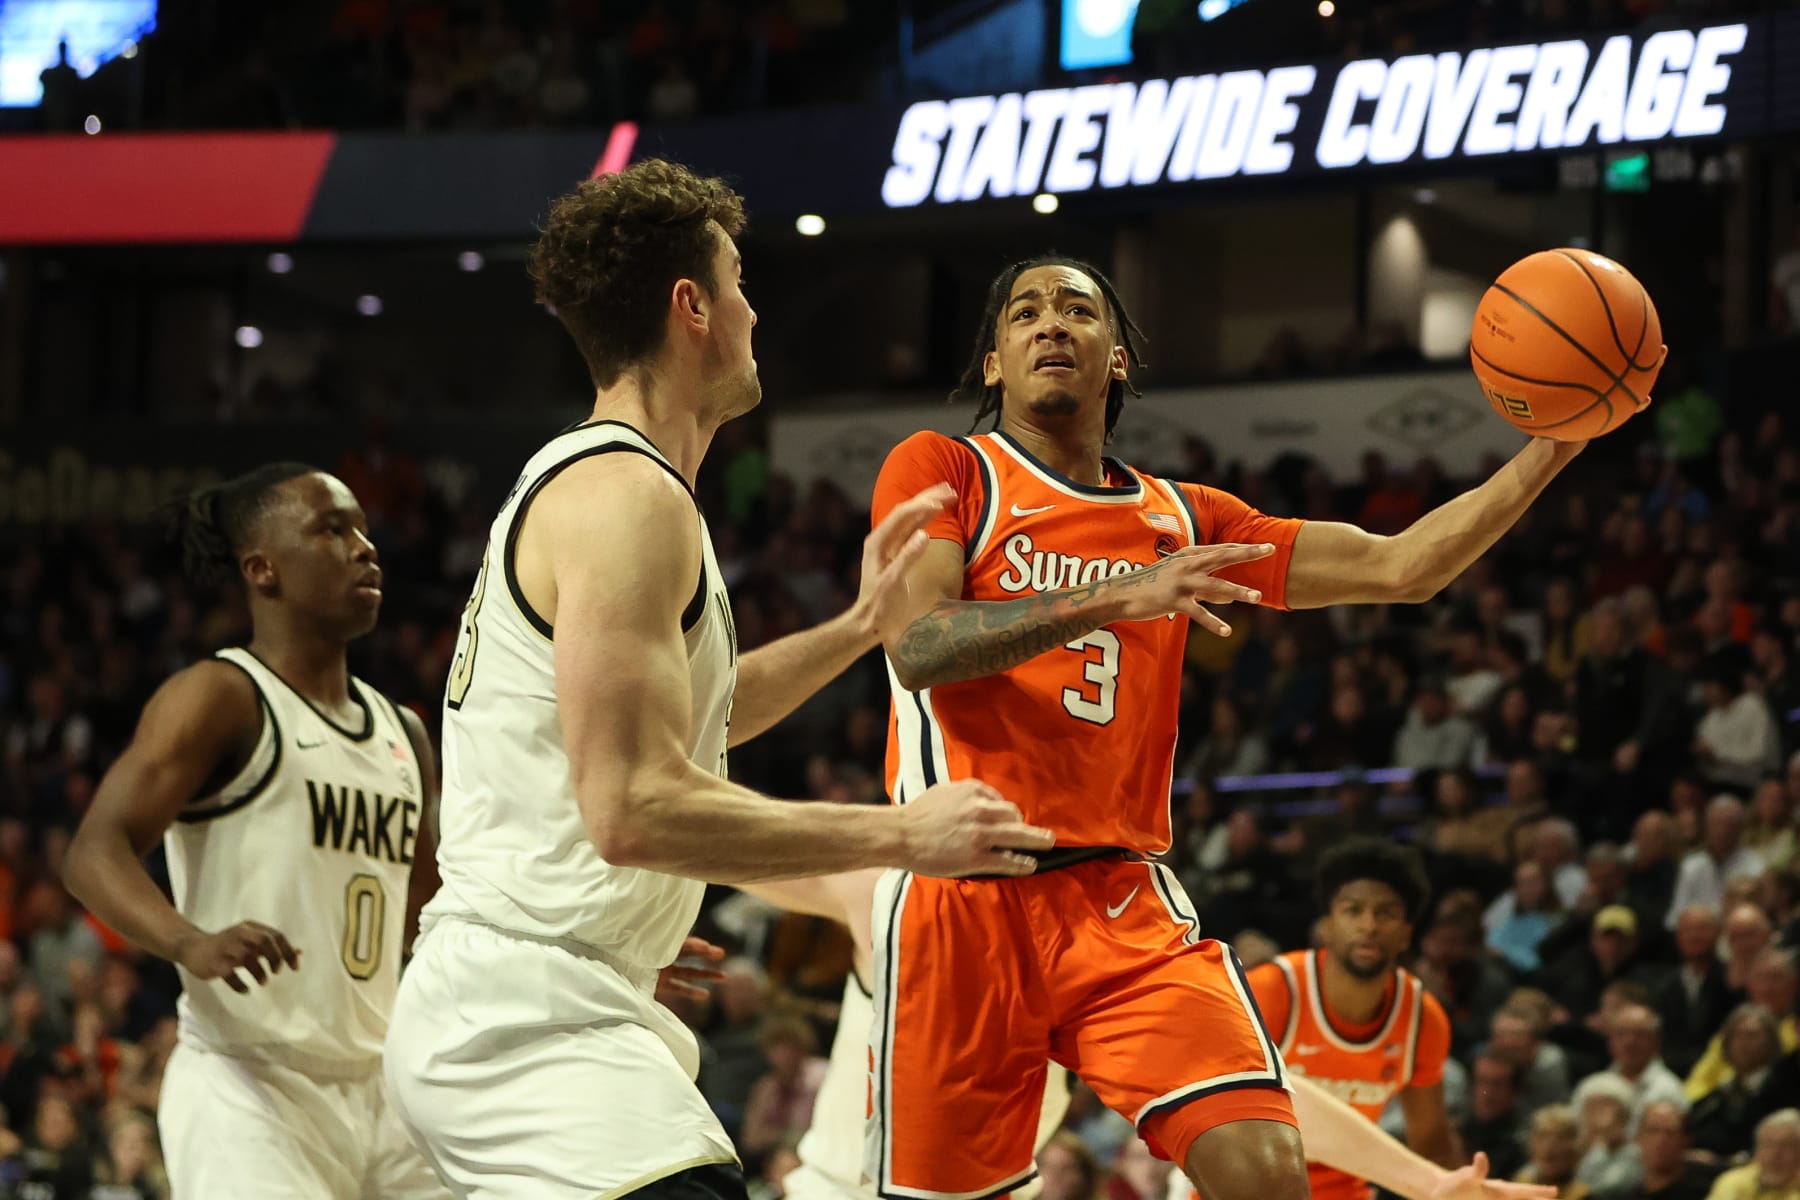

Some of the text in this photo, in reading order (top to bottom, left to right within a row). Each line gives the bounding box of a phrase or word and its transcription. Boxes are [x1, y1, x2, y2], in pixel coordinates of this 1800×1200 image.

[882, 24, 1748, 208] STATEWIDE COVERAGE
[1061, 627, 1122, 727] 3
[305, 778, 417, 866] WAKE
[342, 872, 386, 982] 0
